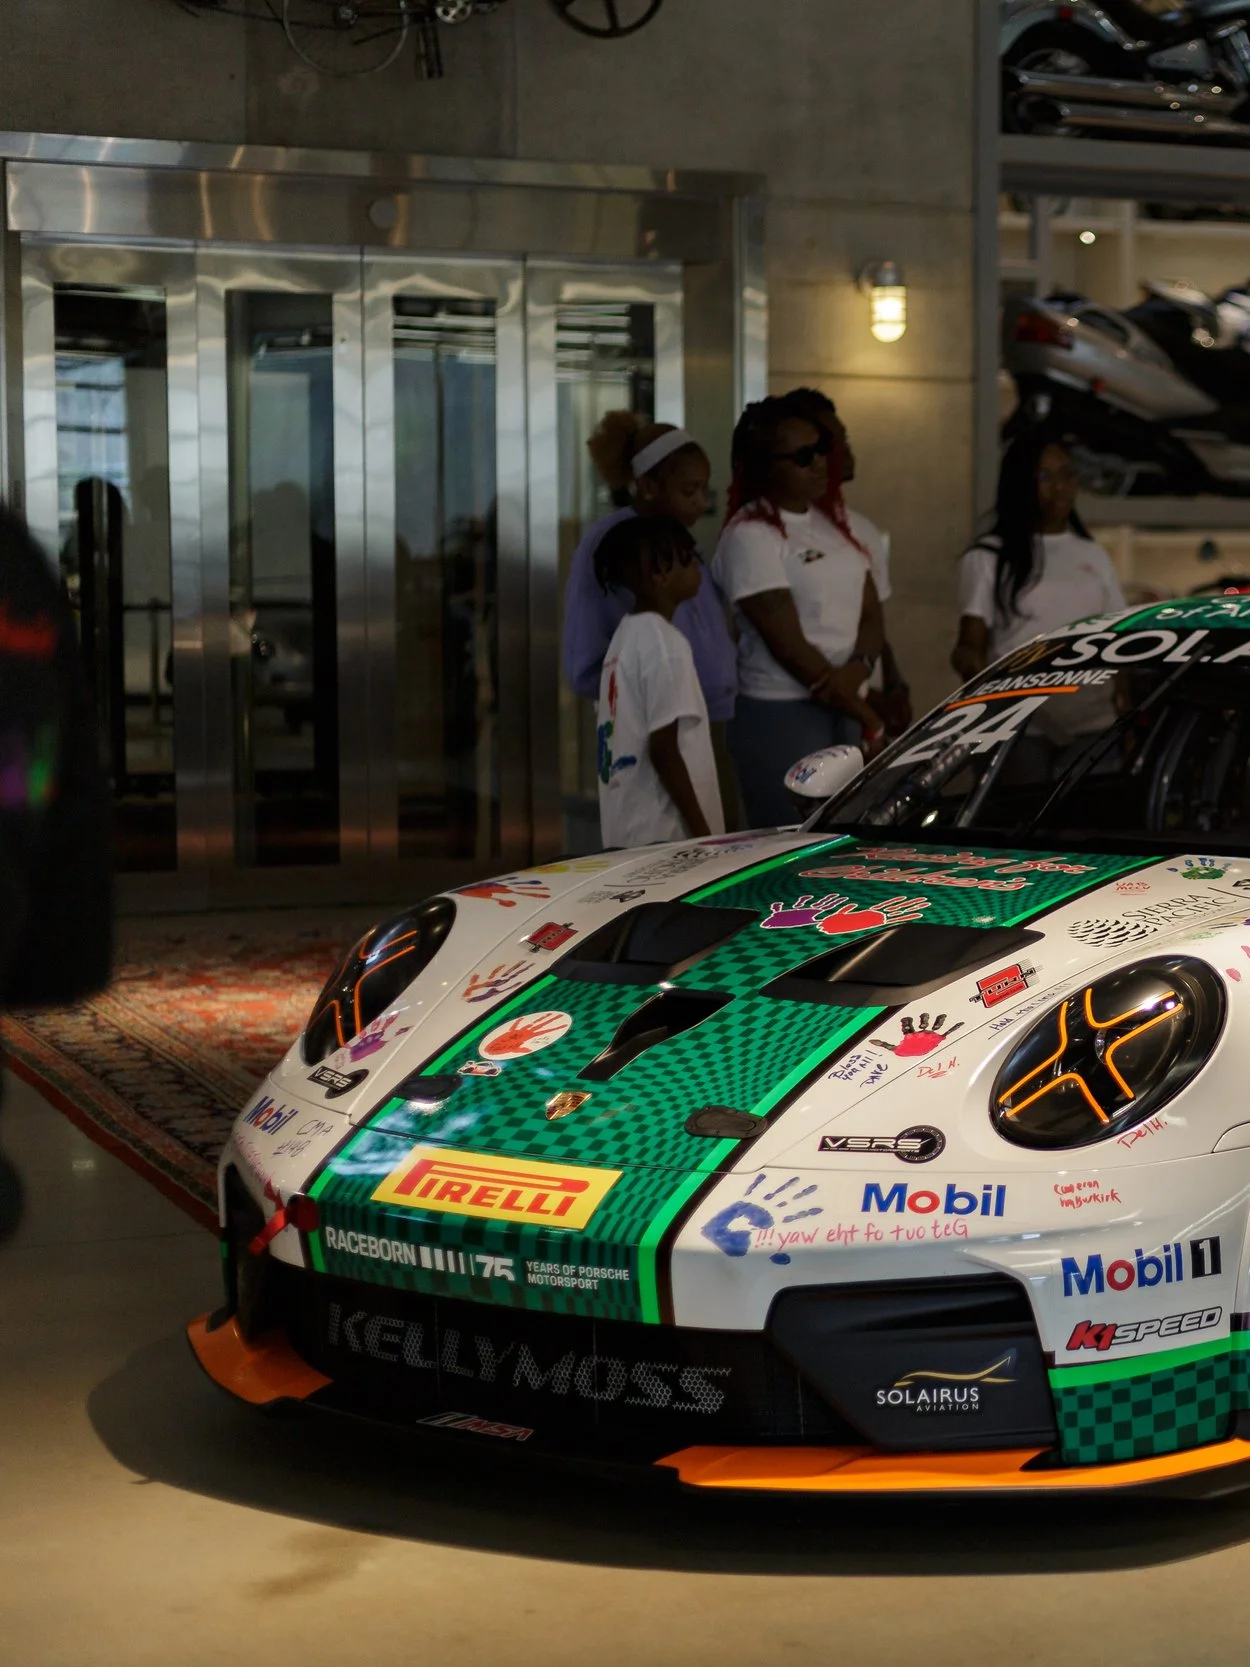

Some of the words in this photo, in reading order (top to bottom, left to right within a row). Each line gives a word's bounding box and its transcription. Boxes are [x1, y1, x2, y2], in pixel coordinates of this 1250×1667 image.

[1155, 604, 1200, 620] of
[887, 696, 1049, 769] 24
[1122, 894, 1211, 922] SIERRA
[1144, 897, 1237, 926] PACIFIC
[314, 1067, 352, 1088] VSRS
[243, 1096, 299, 1136] Mobil
[825, 1138, 922, 1149] VSRS
[393, 1158, 590, 1217] PIRELLI
[860, 1182, 1007, 1217] Mobil
[324, 1226, 417, 1266] RACEBORN
[474, 1254, 516, 1282] 75
[526, 1260, 561, 1276] YEARS
[562, 1263, 577, 1277] OF
[579, 1265, 630, 1281] PORSCHE
[1061, 1242, 1184, 1297] Mobil
[1193, 1237, 1217, 1277] 1
[527, 1273, 599, 1290] MOTORSPORT
[876, 1386, 980, 1405] SOLAIRUS
[916, 1402, 980, 1412] AVIATION
